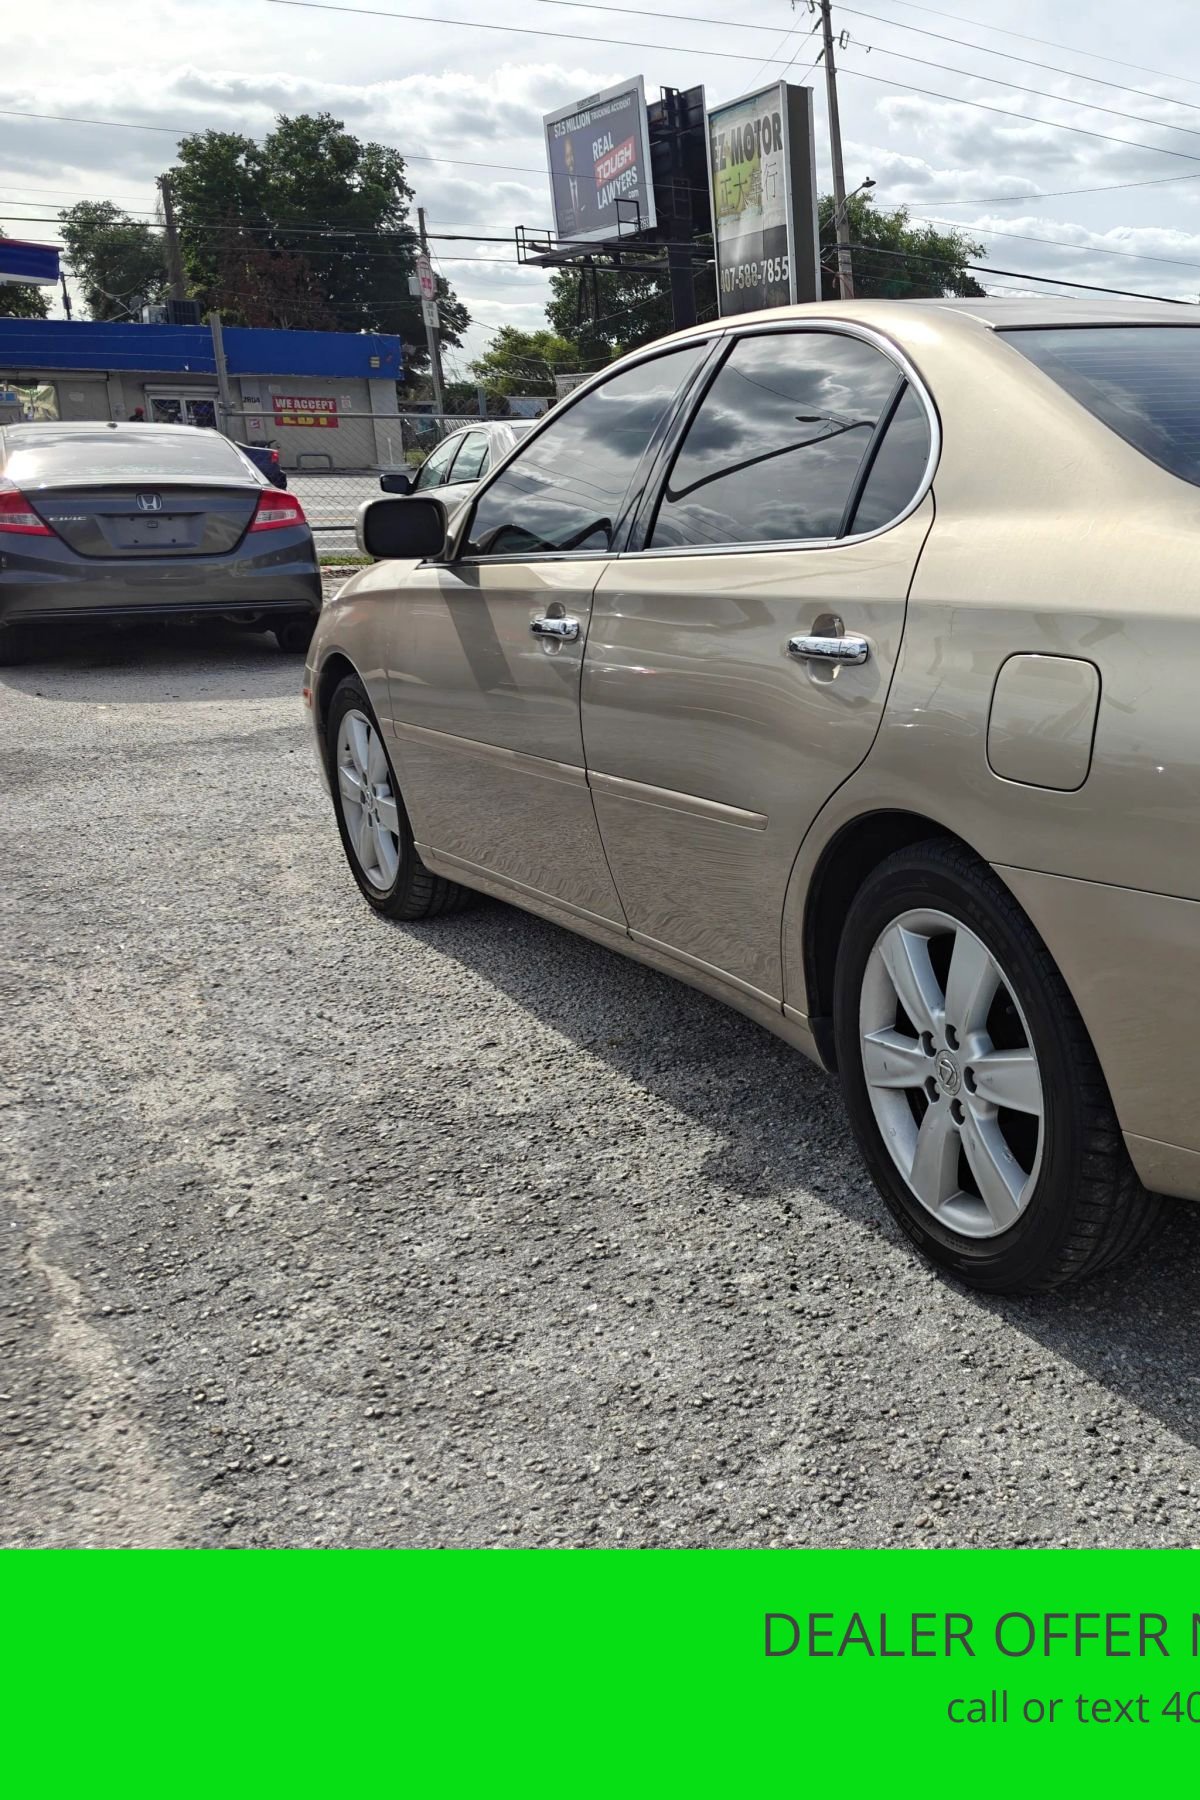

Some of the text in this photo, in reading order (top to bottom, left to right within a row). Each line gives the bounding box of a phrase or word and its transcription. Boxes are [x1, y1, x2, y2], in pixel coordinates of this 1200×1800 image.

[554, 123, 567, 138] $7.5
[566, 111, 591, 132] MILLION
[591, 106, 611, 120] TRUCKING
[611, 98, 631, 112] ACCIDENT
[592, 131, 614, 162] REAL
[731, 112, 783, 167] MOTOR
[596, 143, 632, 182] TOUGH
[596, 165, 638, 210] LAWYERS
[720, 255, 790, 293] 407-588-7855
[274, 398, 293, 408] WE
[293, 399, 334, 410] ACCEPT
[282, 408, 330, 426] EBT
